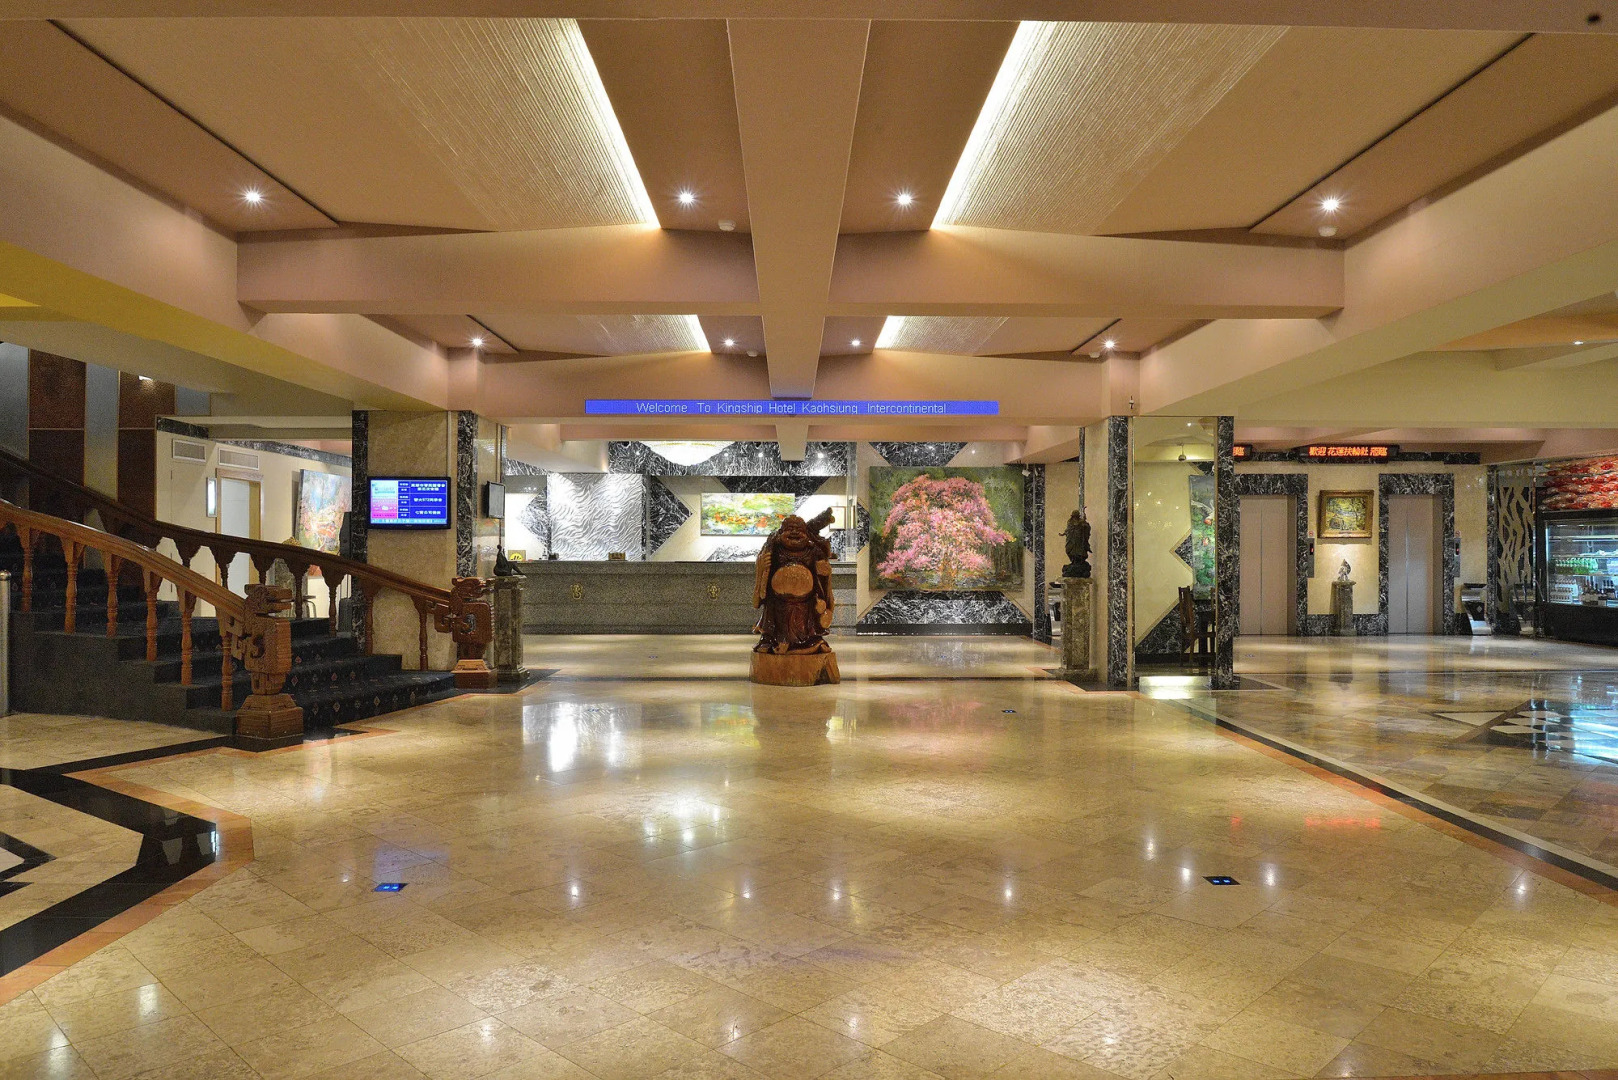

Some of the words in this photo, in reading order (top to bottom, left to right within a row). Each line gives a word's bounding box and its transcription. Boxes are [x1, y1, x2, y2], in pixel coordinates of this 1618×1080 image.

[636, 402, 688, 413] Welcome
[697, 402, 711, 413] To
[717, 402, 763, 414] Kingship
[768, 402, 796, 413] Hotel
[802, 402, 858, 414] Kaohsiung
[867, 402, 947, 414] Intercontinental
